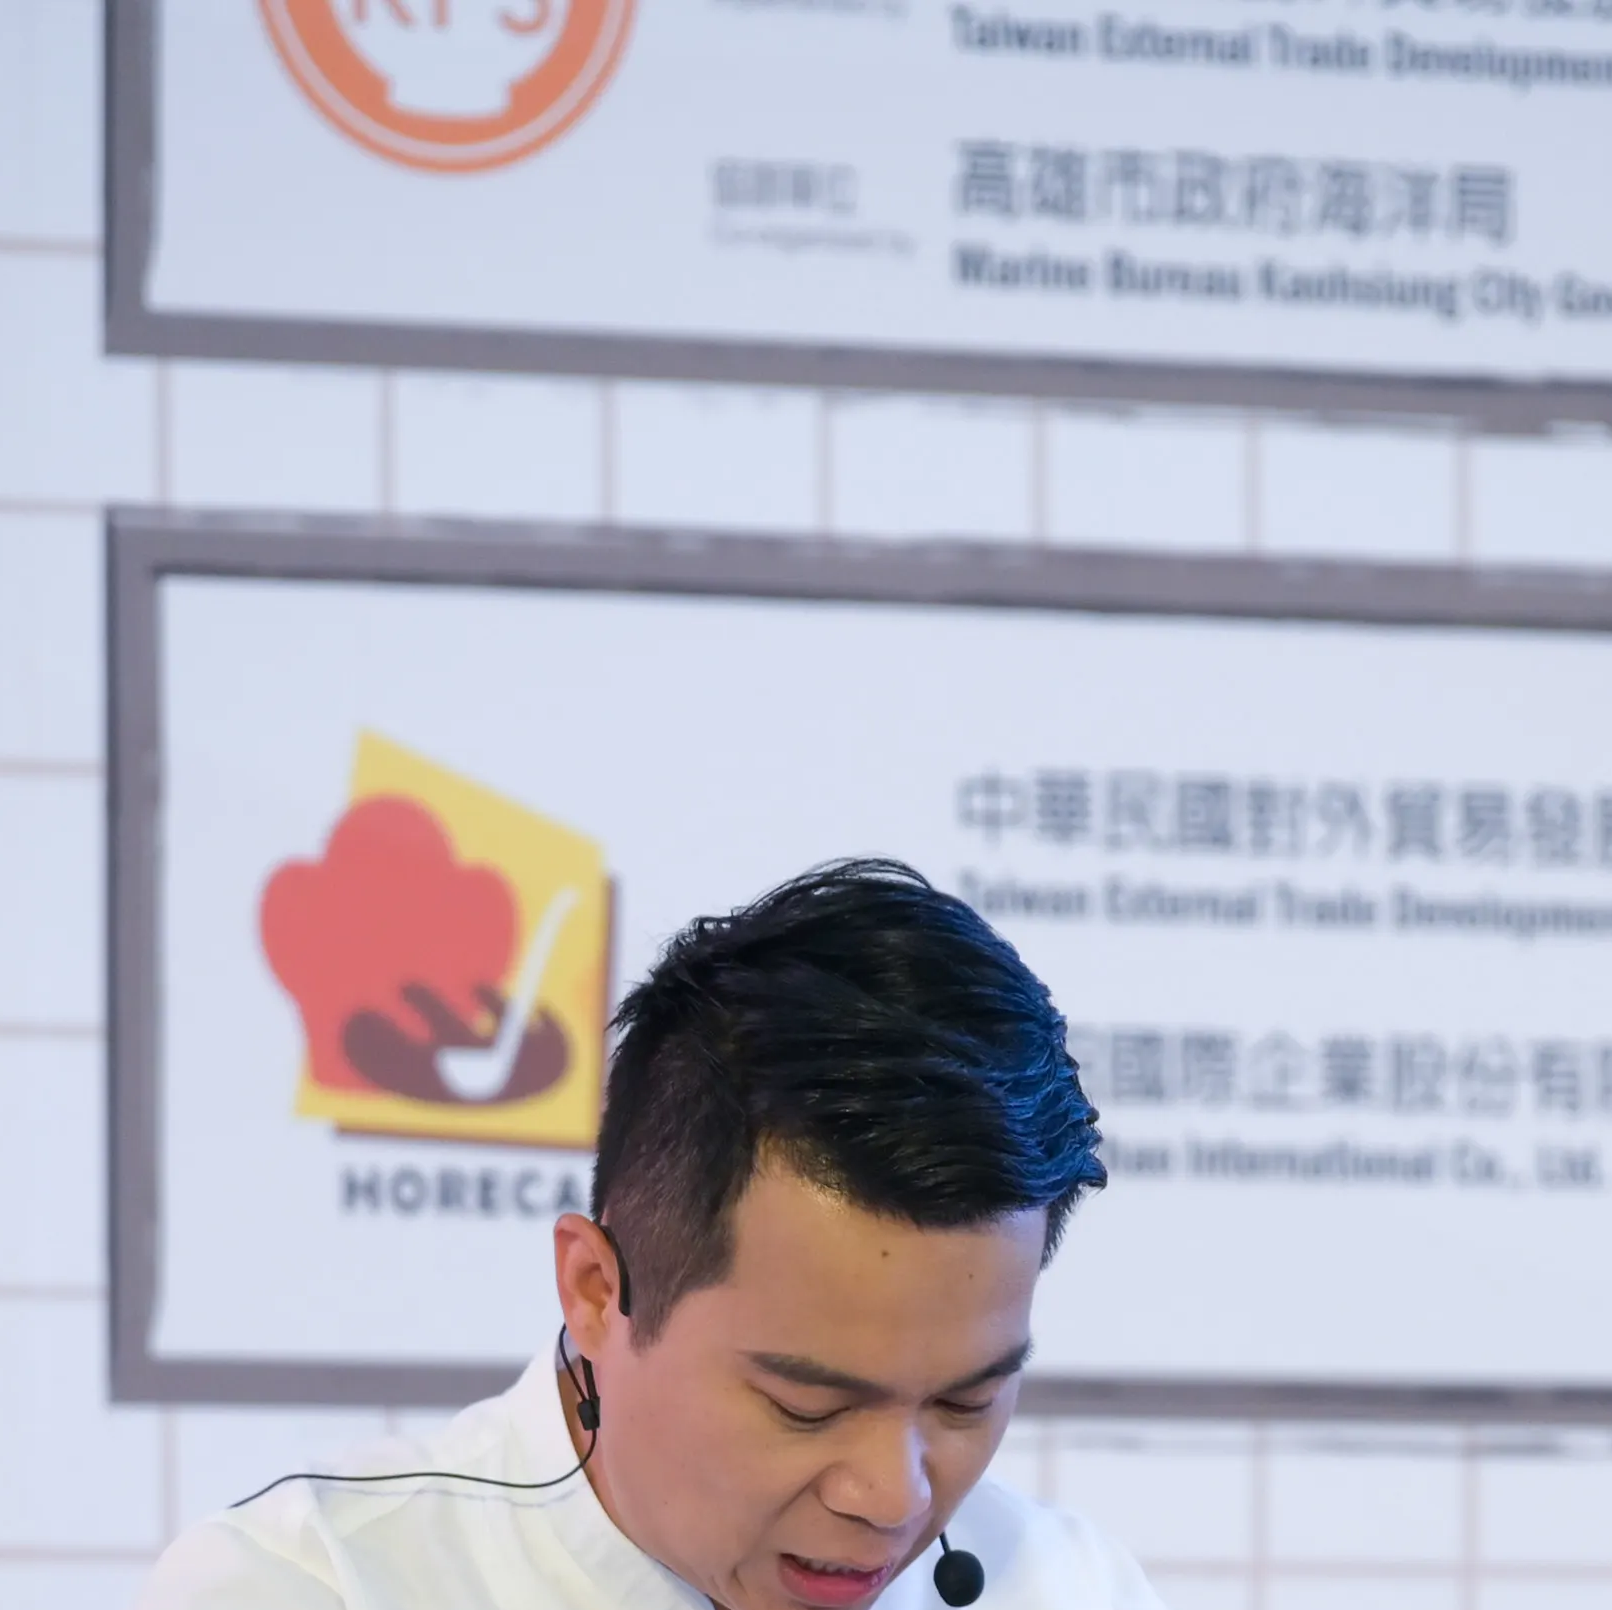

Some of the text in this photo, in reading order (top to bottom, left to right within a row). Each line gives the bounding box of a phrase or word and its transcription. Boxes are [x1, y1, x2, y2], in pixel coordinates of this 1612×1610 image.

[952, 6, 1085, 57] Taiwan
[1096, 13, 1253, 66] External
[1269, 23, 1372, 72] Trade
[954, 138, 1517, 246] 高雄市政府海洋局
[952, 242, 1088, 290] Marine
[1103, 249, 1241, 298] Bureau
[1256, 257, 1459, 325] Kaohsiung
[1471, 266, 1543, 327] City
[1103, 873, 1259, 926] External
[1274, 878, 1377, 930] Trade
[1184, 1133, 1439, 1187] International
[342, 1165, 584, 1219] HORECA
